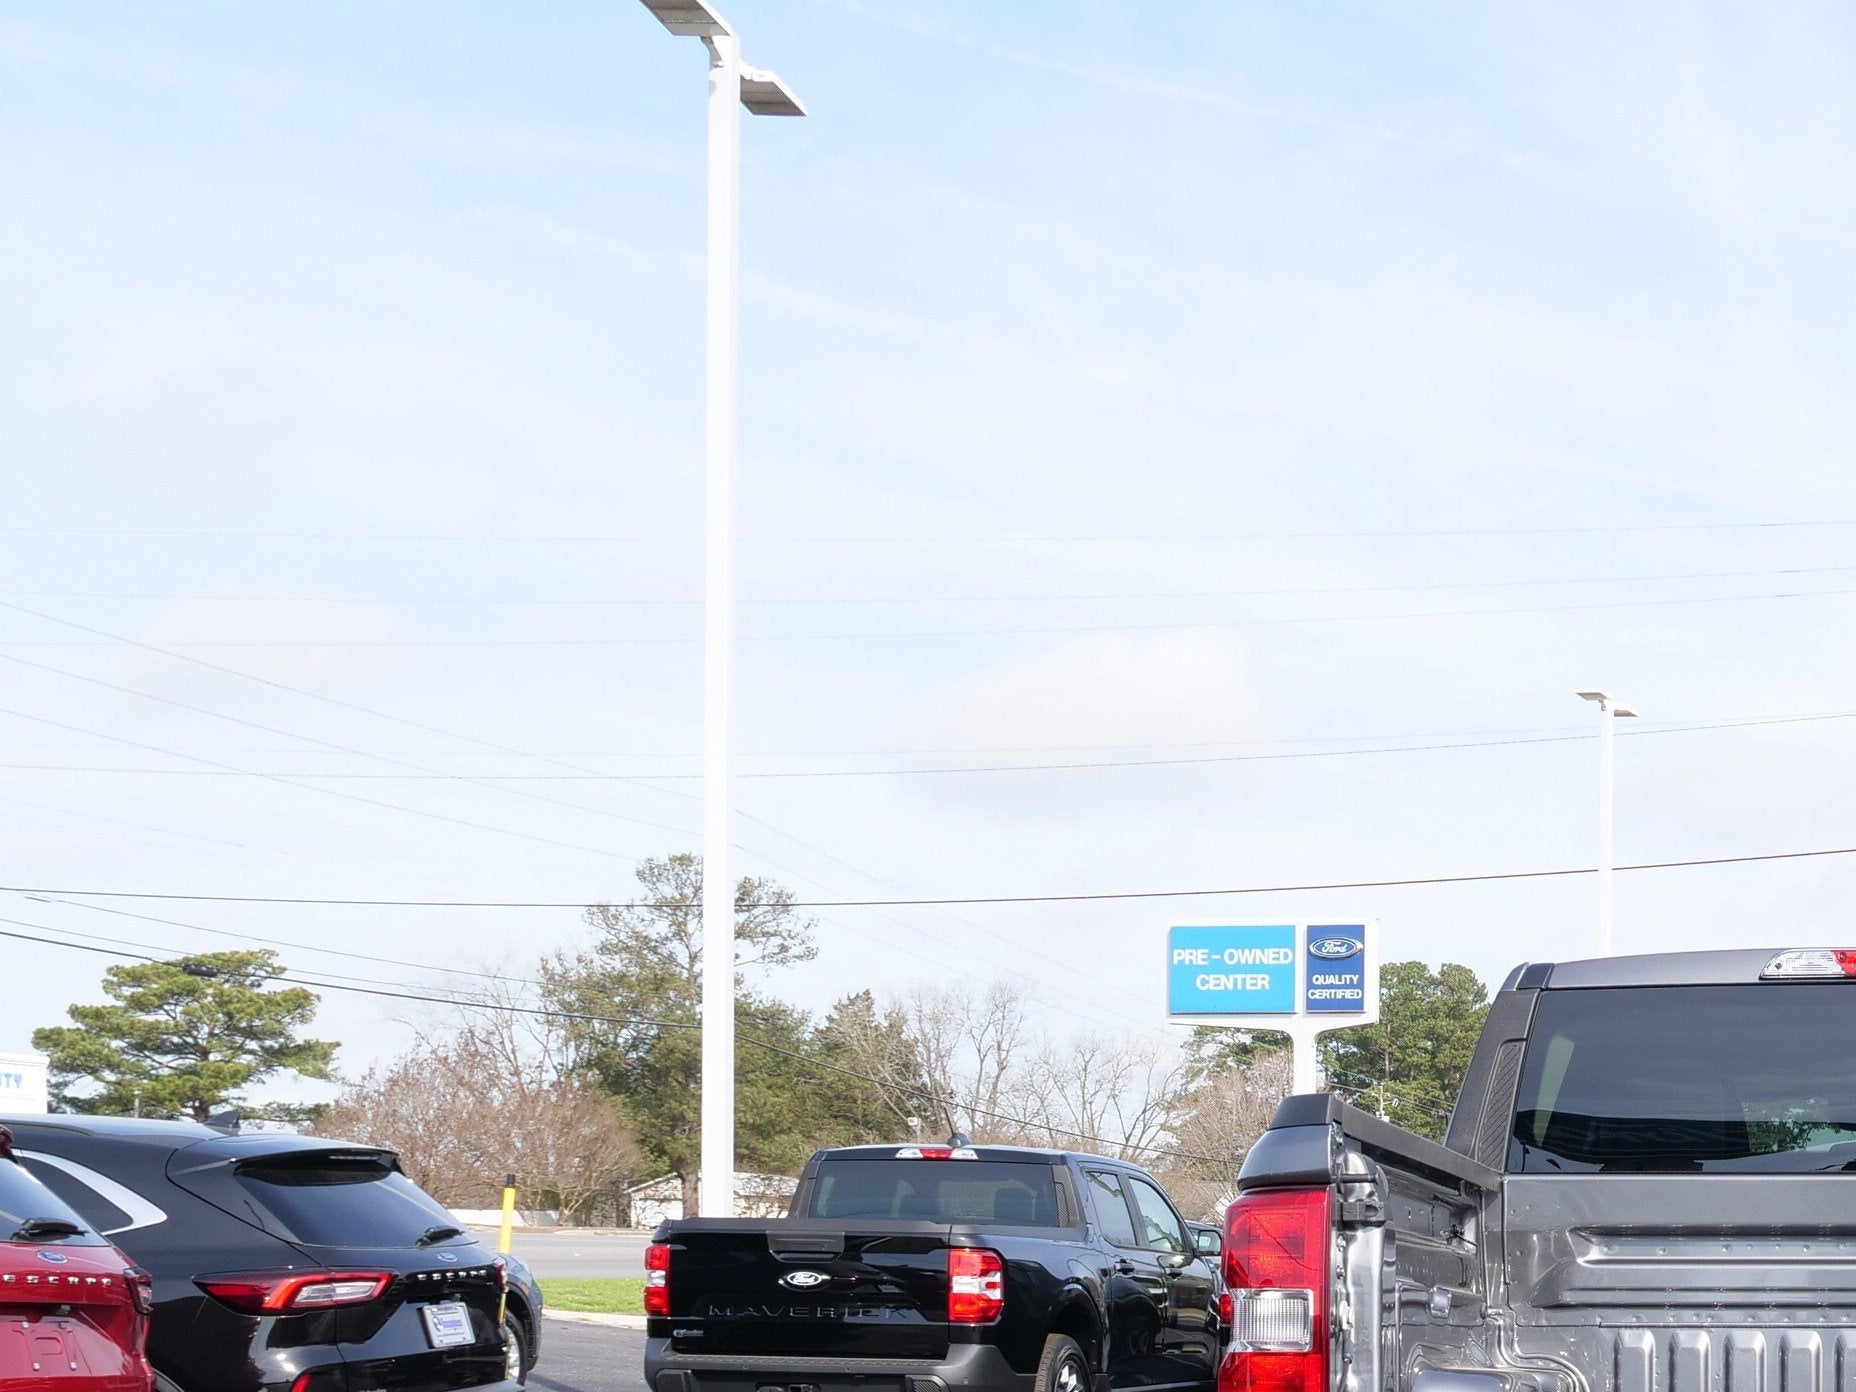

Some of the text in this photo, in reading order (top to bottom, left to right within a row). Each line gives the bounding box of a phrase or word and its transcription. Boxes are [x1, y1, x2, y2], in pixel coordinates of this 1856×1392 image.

[1321, 940, 1348, 953] Ford
[1195, 974, 1270, 990] CENTER
[1312, 974, 1359, 985] QUALITY
[1307, 989, 1362, 999] CERTIFIED
[3, 1274, 111, 1285] ESCAPE
[709, 1304, 907, 1317] MAVERICK
